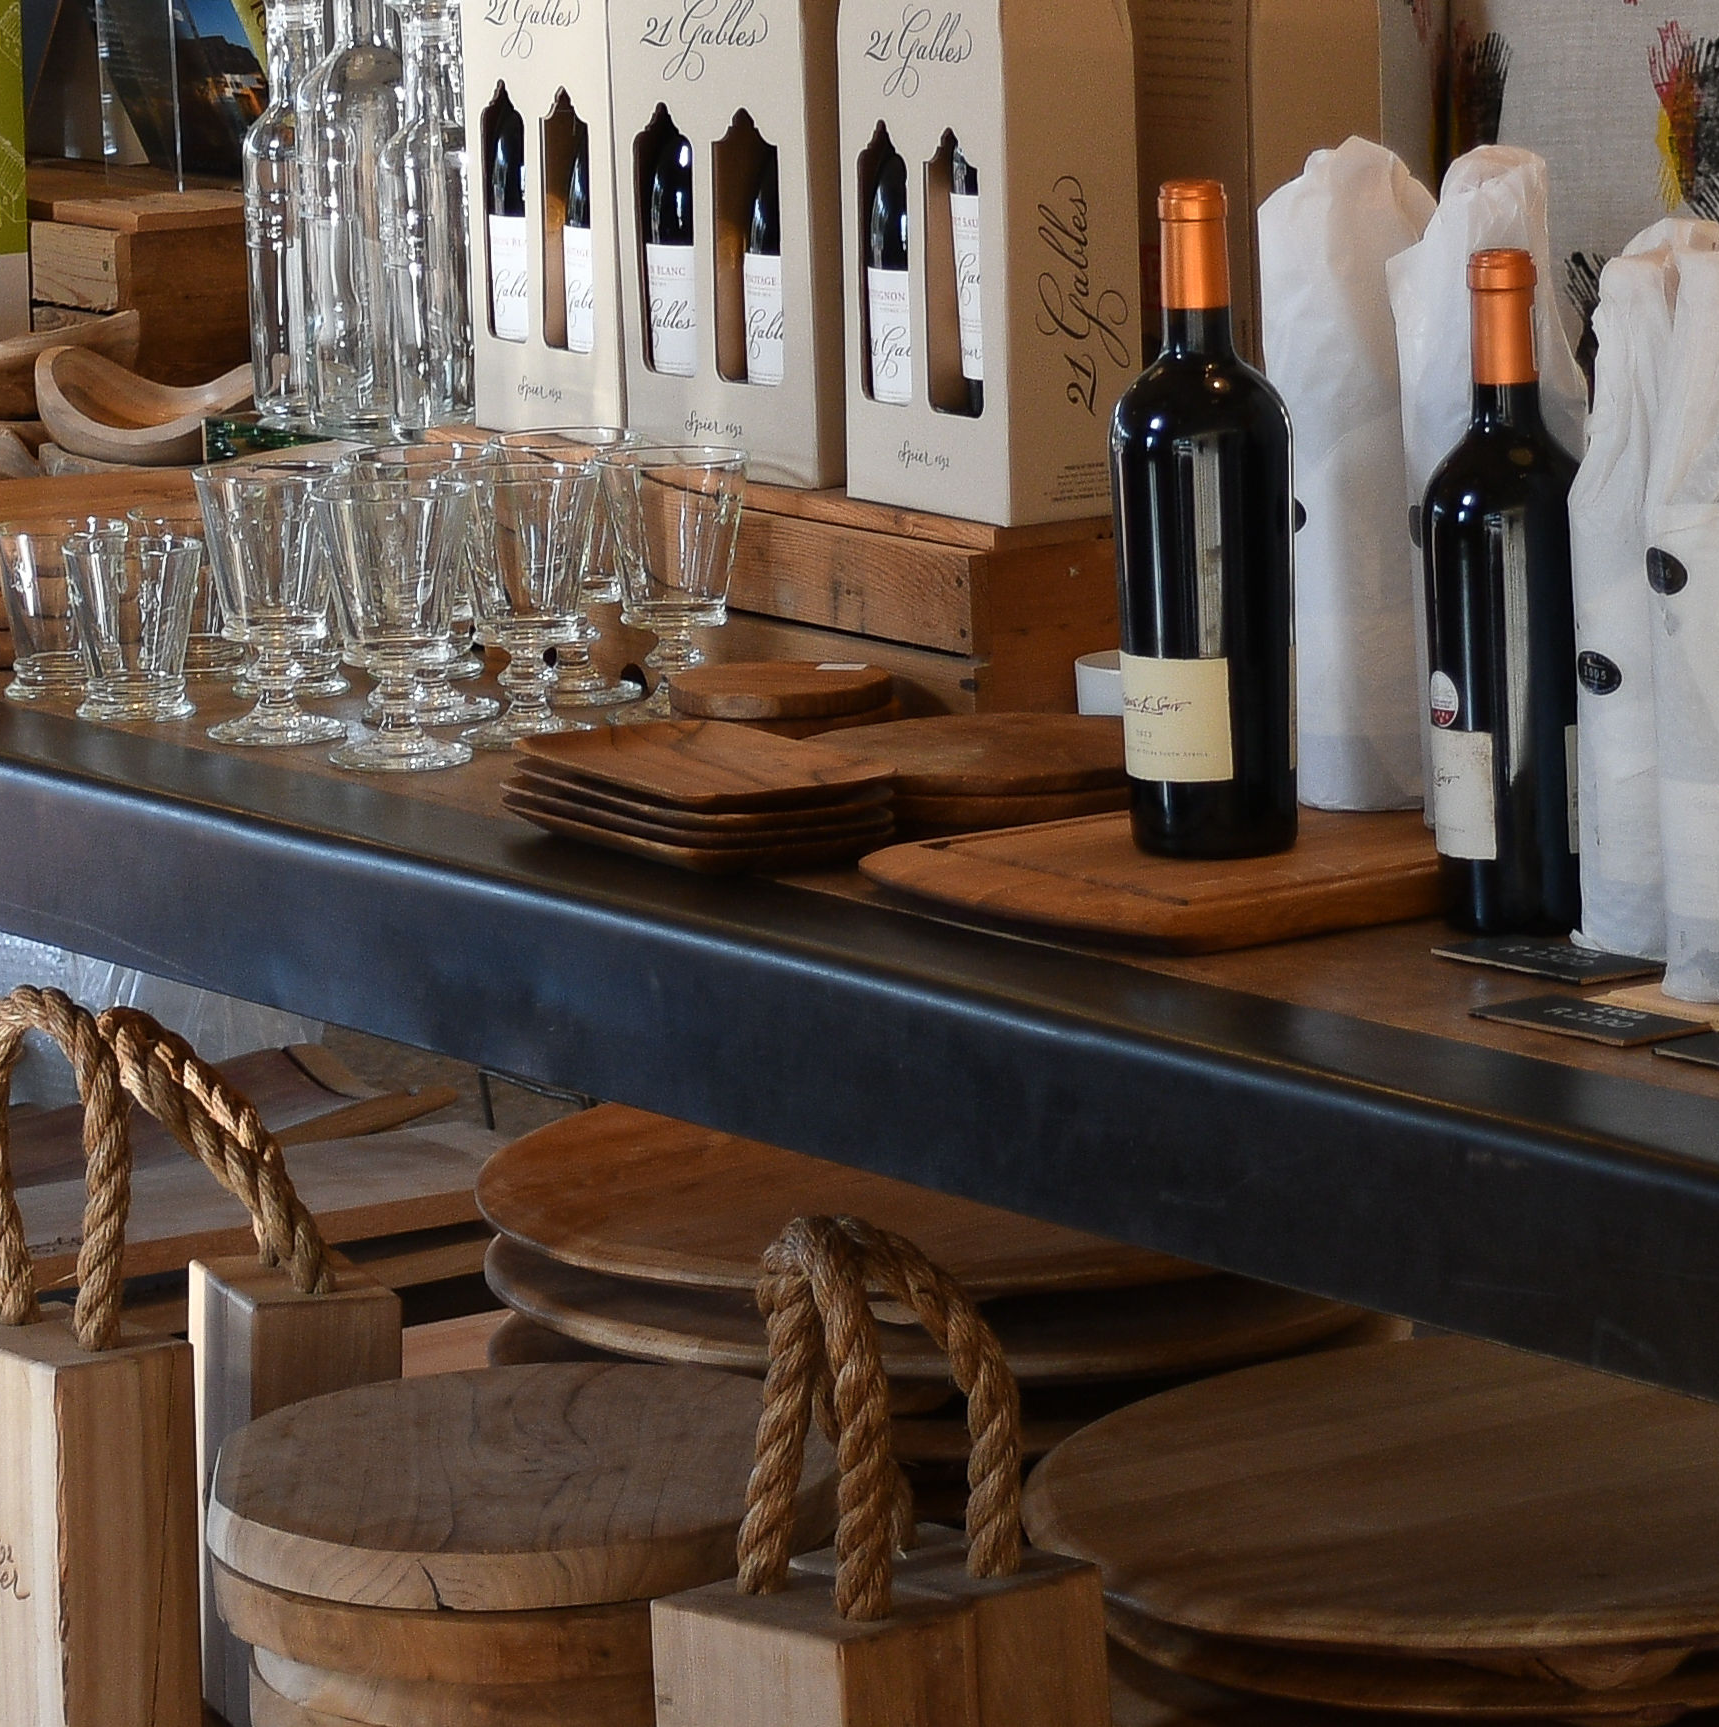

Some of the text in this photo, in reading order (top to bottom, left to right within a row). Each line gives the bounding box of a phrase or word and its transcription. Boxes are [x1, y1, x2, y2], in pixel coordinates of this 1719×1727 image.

[640, 16, 674, 47] 21
[864, 3, 972, 98] 21 Gables
[1035, 176, 1131, 369] Gables
[517, 375, 549, 401] Spier
[1064, 353, 1097, 417] 21
[684, 410, 725, 439] Spier
[898, 440, 932, 468] Spier
